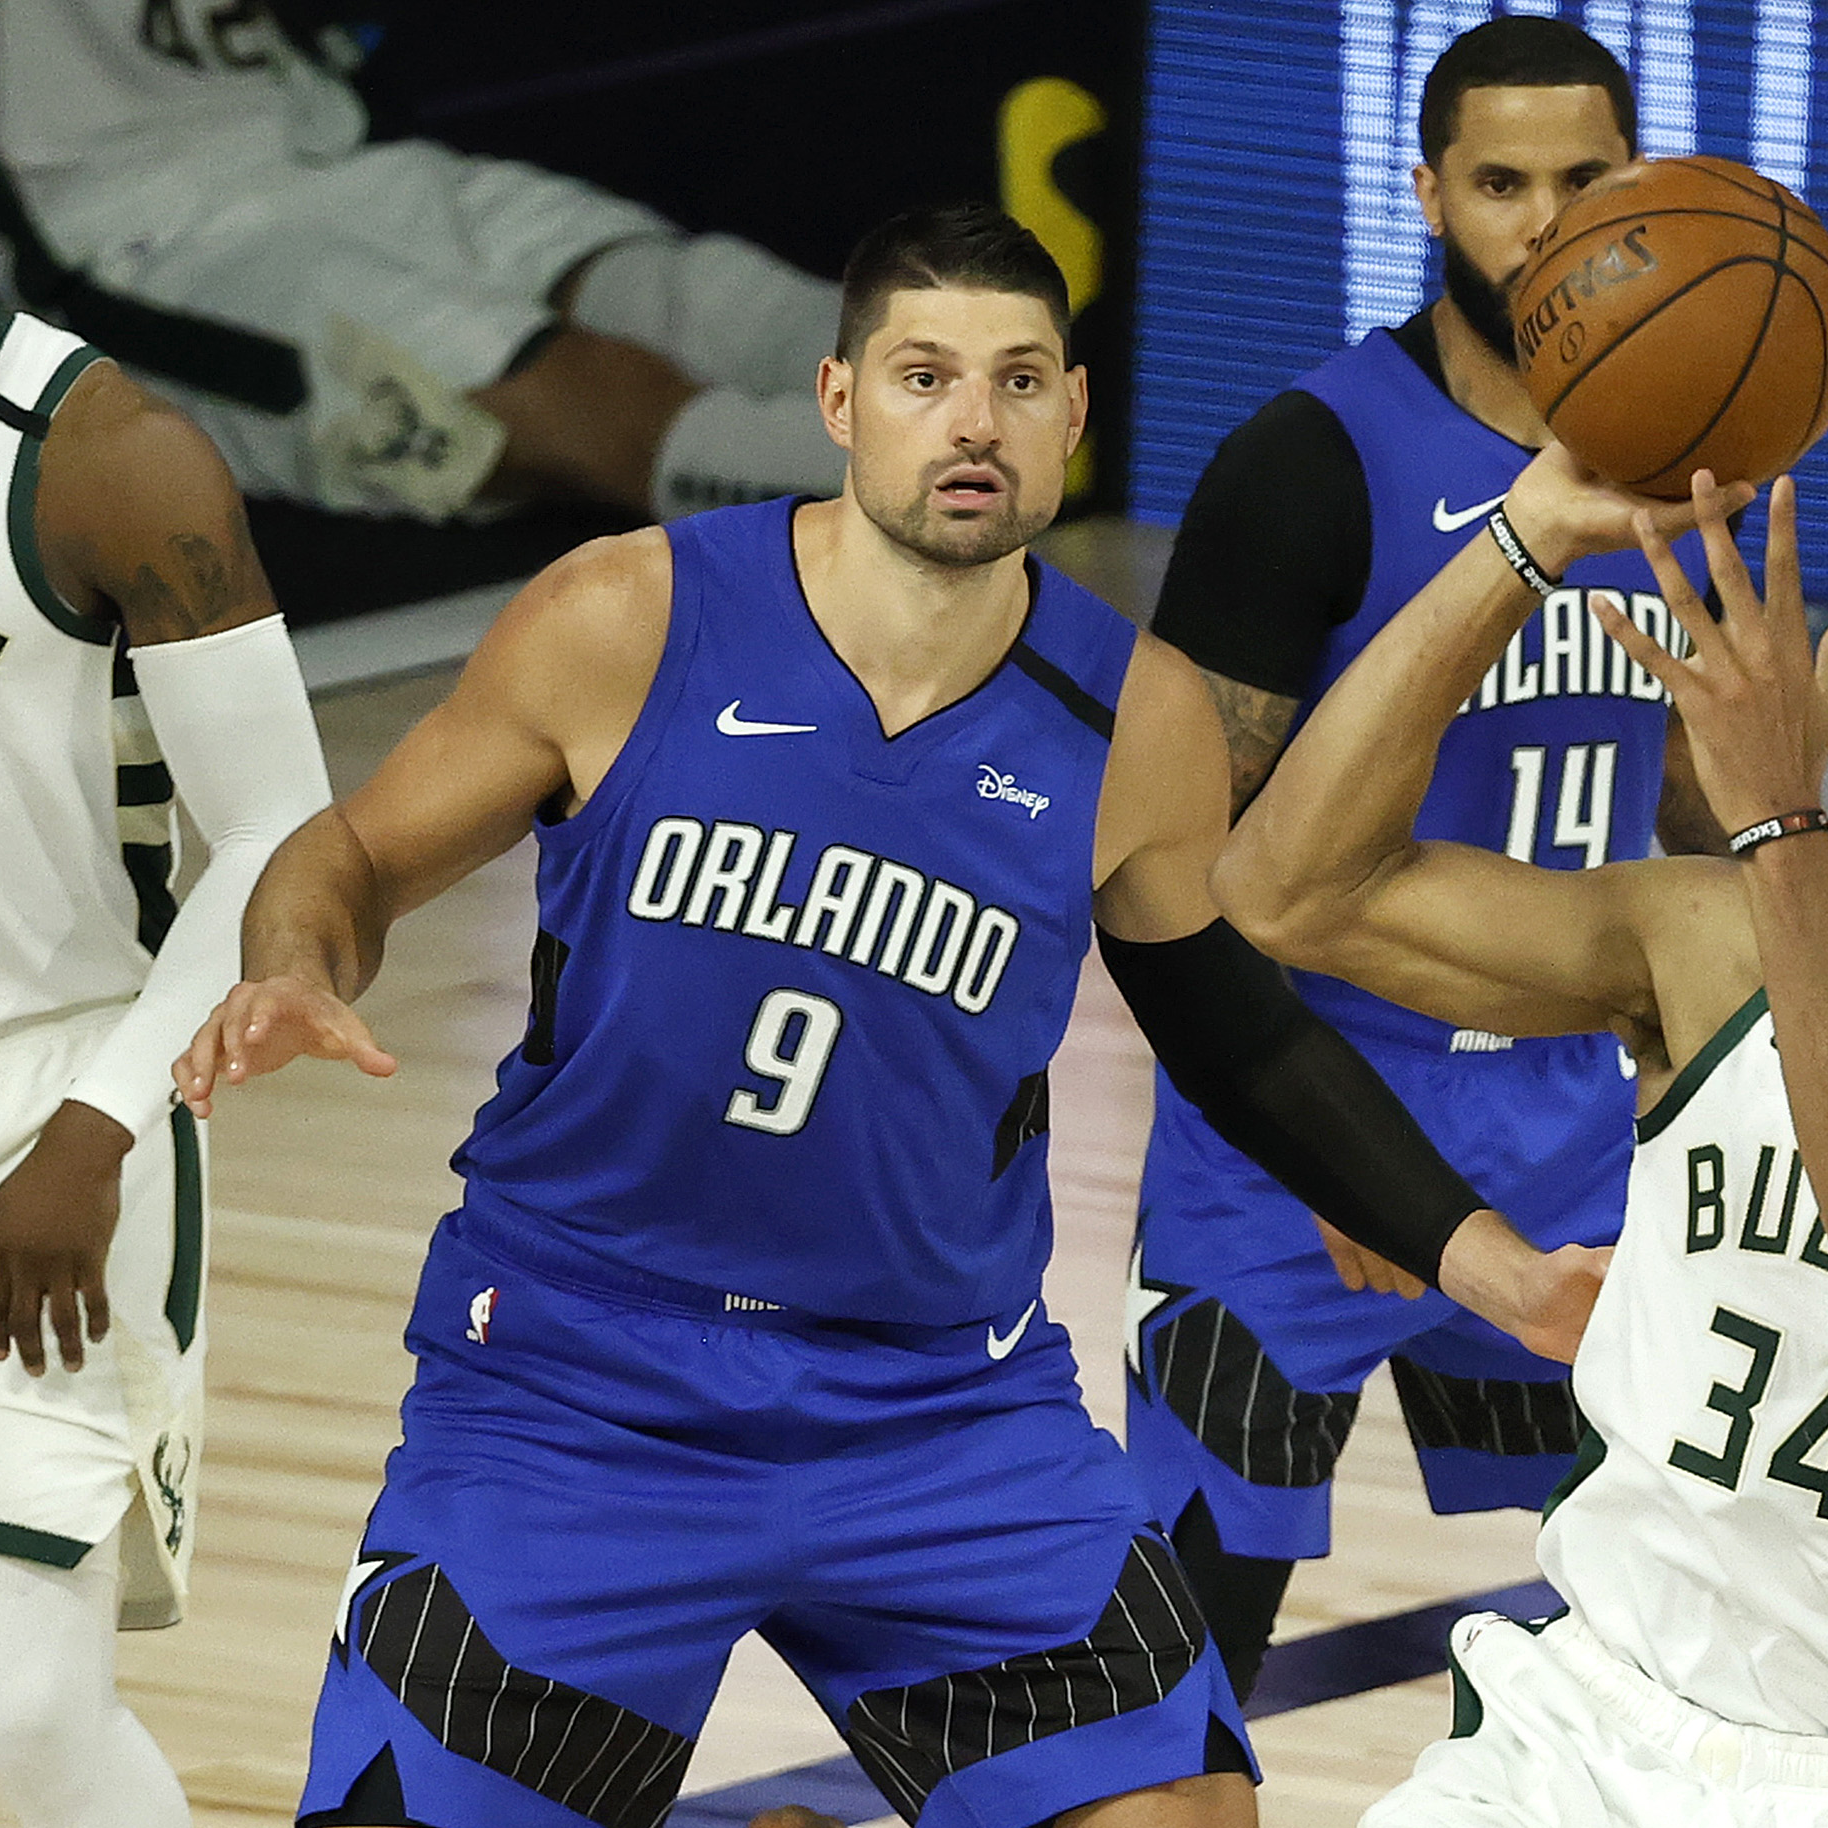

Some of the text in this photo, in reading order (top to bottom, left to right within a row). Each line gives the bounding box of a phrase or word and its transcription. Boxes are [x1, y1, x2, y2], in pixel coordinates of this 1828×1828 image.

[1513, 223, 1659, 373] SPALDIN
[1489, 511, 1528, 570] History
[1456, 587, 1691, 715] LAND
[976, 764, 1051, 820] Disney
[1506, 741, 1618, 870] 14
[627, 815, 1021, 1016] ORLANDO
[723, 986, 843, 1137] 9
